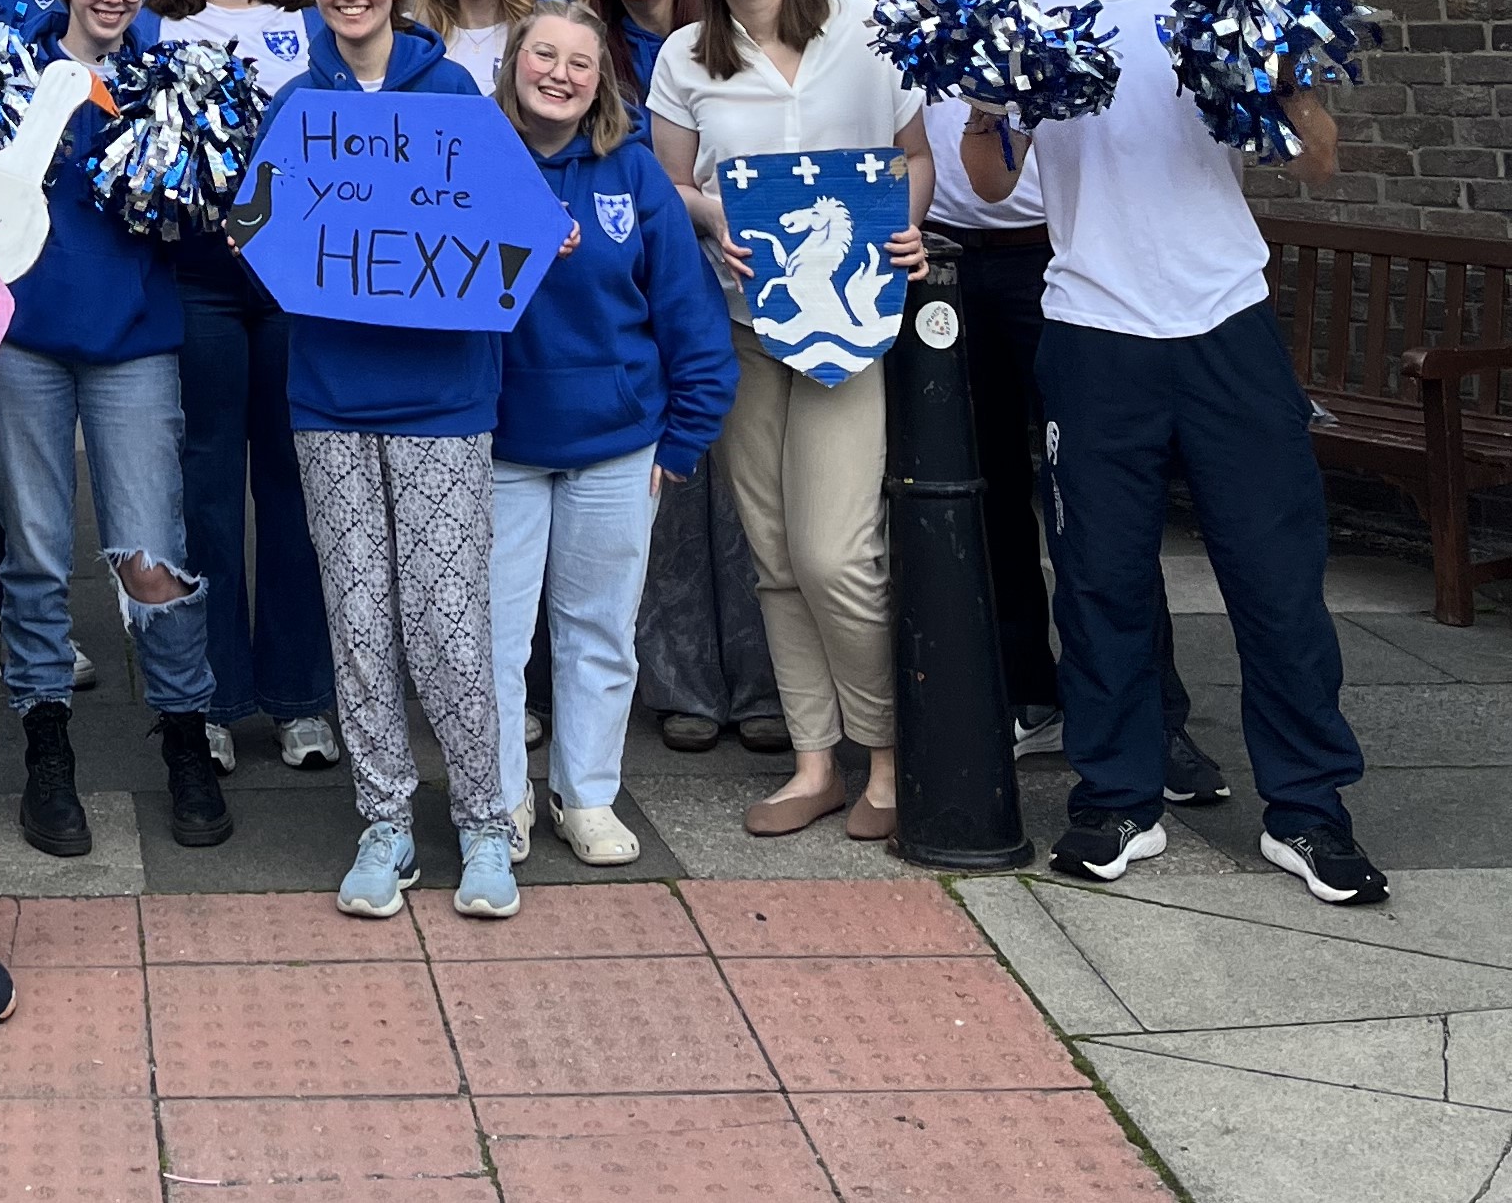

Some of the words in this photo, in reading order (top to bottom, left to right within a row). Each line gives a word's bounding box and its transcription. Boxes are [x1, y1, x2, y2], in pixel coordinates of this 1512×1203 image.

[302, 110, 410, 164] Honk
[435, 129, 462, 182] if
[302, 177, 373, 221] you
[410, 185, 473, 209] are
[316, 224, 533, 310] HEXY!
